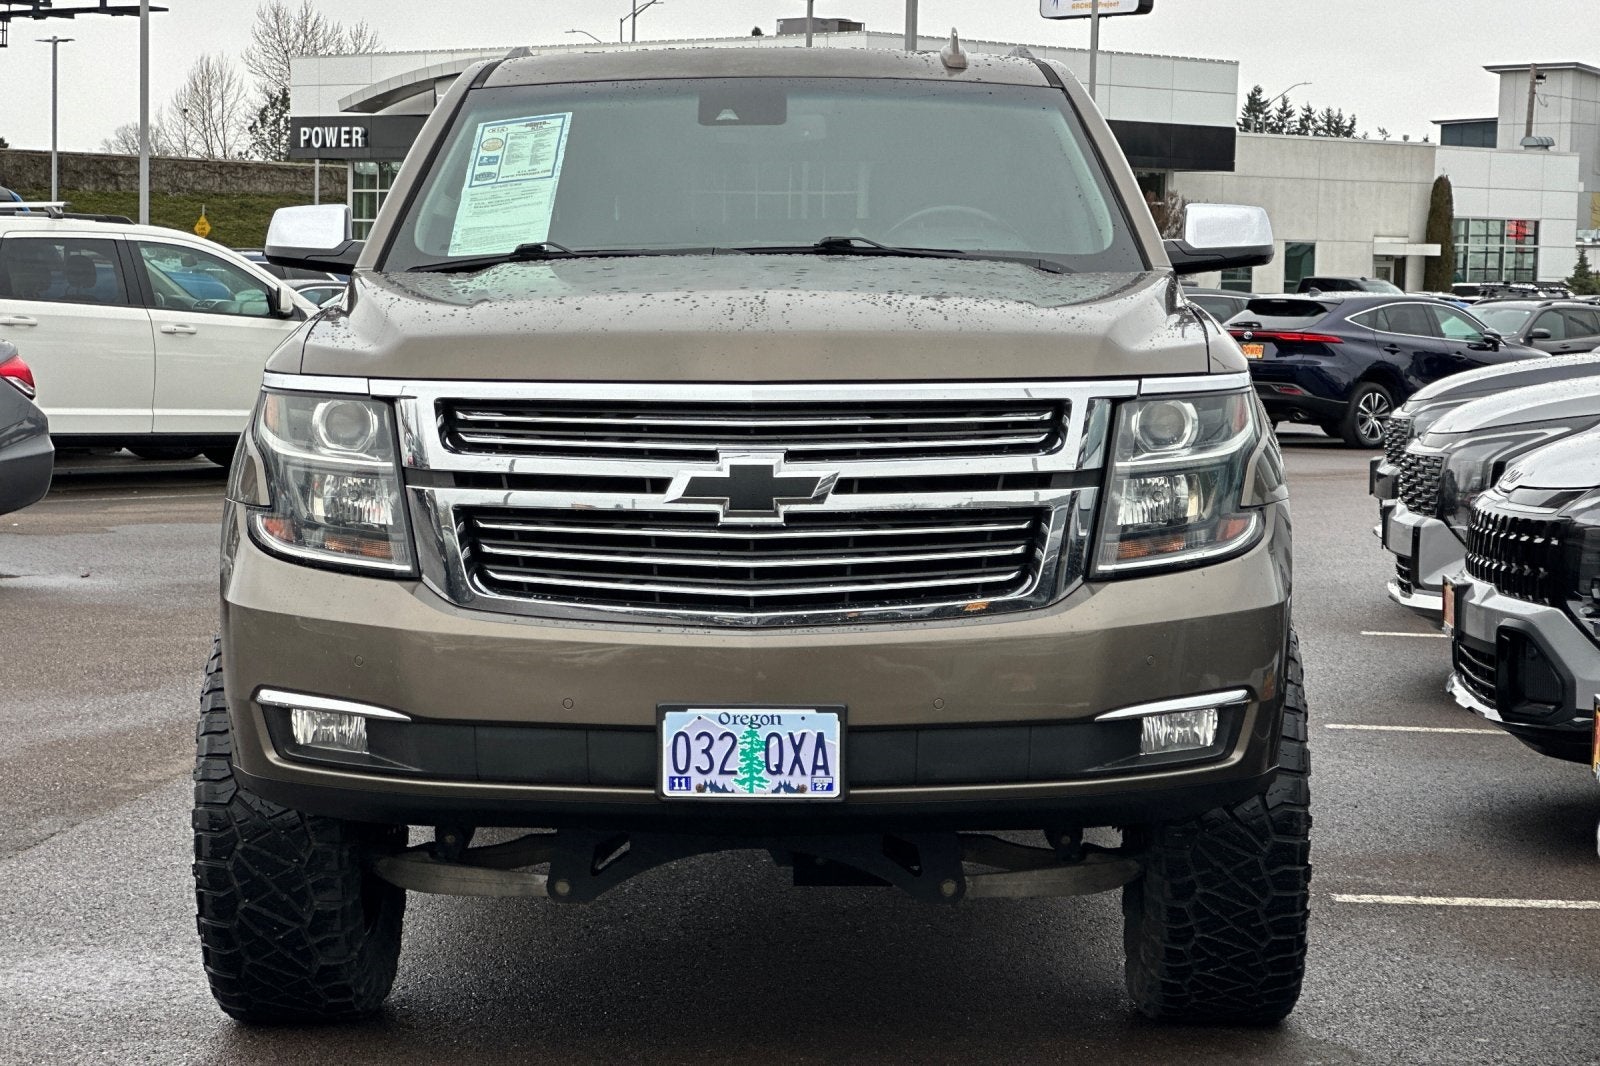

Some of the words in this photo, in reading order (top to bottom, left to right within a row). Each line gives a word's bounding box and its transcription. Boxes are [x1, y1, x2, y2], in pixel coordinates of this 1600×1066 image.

[300, 126, 365, 148] POWER
[718, 711, 783, 729] Oregon
[671, 731, 738, 776] 032
[764, 731, 831, 776] QXA
[672, 778, 688, 791] 11
[815, 783, 829, 791] 27
